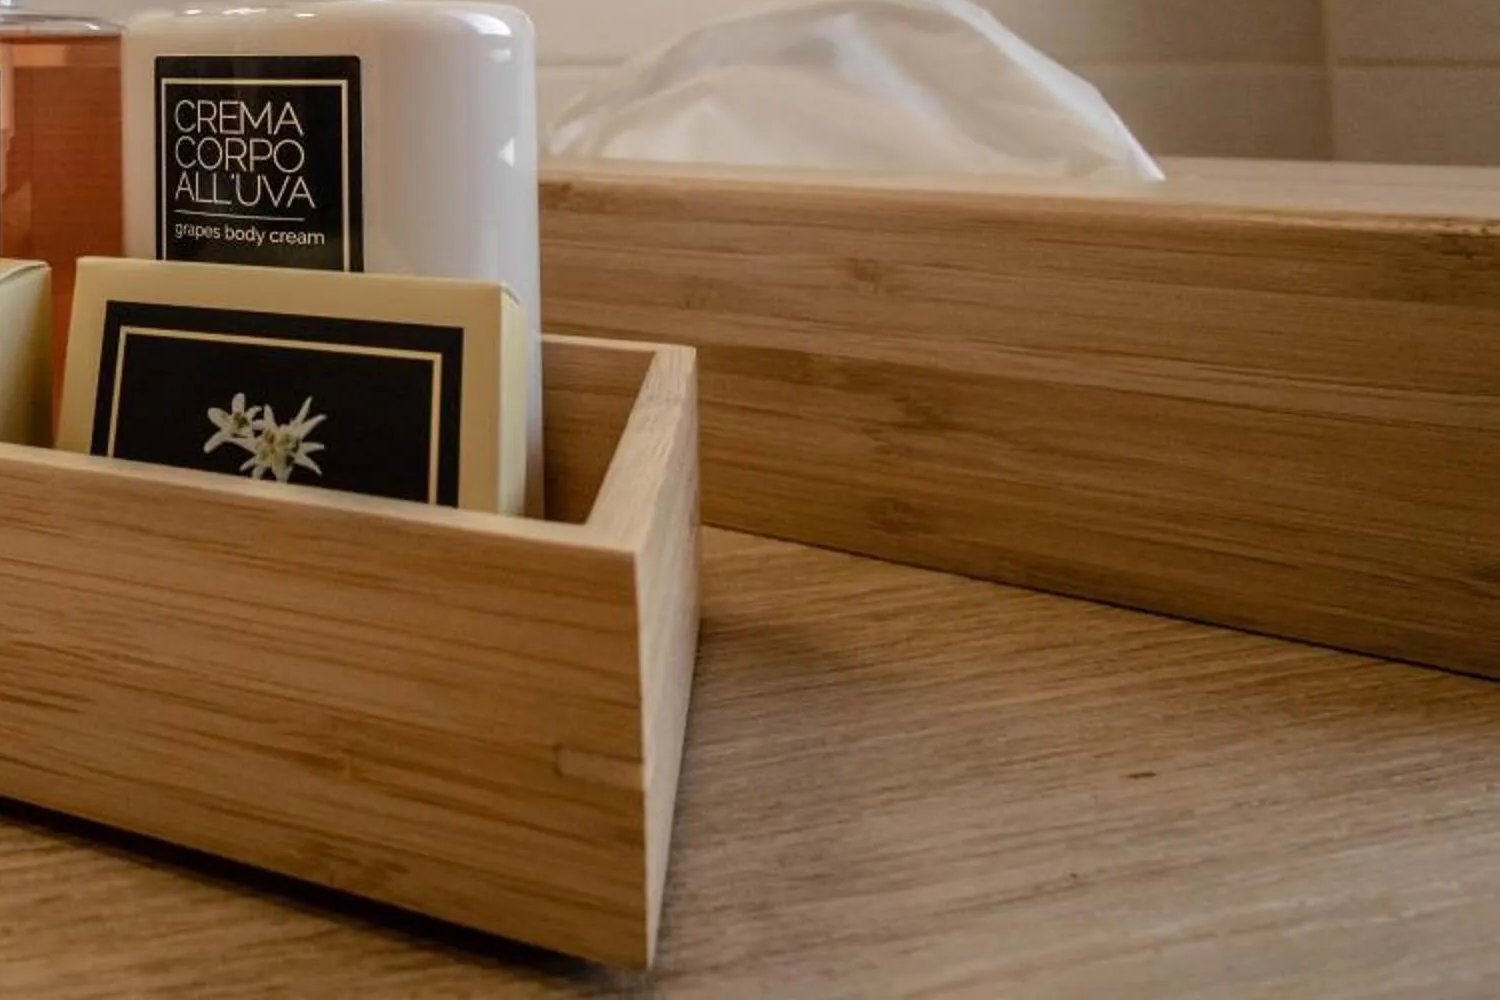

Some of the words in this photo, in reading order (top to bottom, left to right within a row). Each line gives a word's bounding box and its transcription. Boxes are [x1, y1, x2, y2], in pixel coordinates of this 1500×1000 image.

[174, 99, 305, 136] CREMA
[174, 135, 306, 174] CORPO
[174, 171, 316, 209] ALL'UVA
[174, 222, 221, 240] grapes
[224, 224, 265, 247] body
[268, 228, 326, 246] cream
